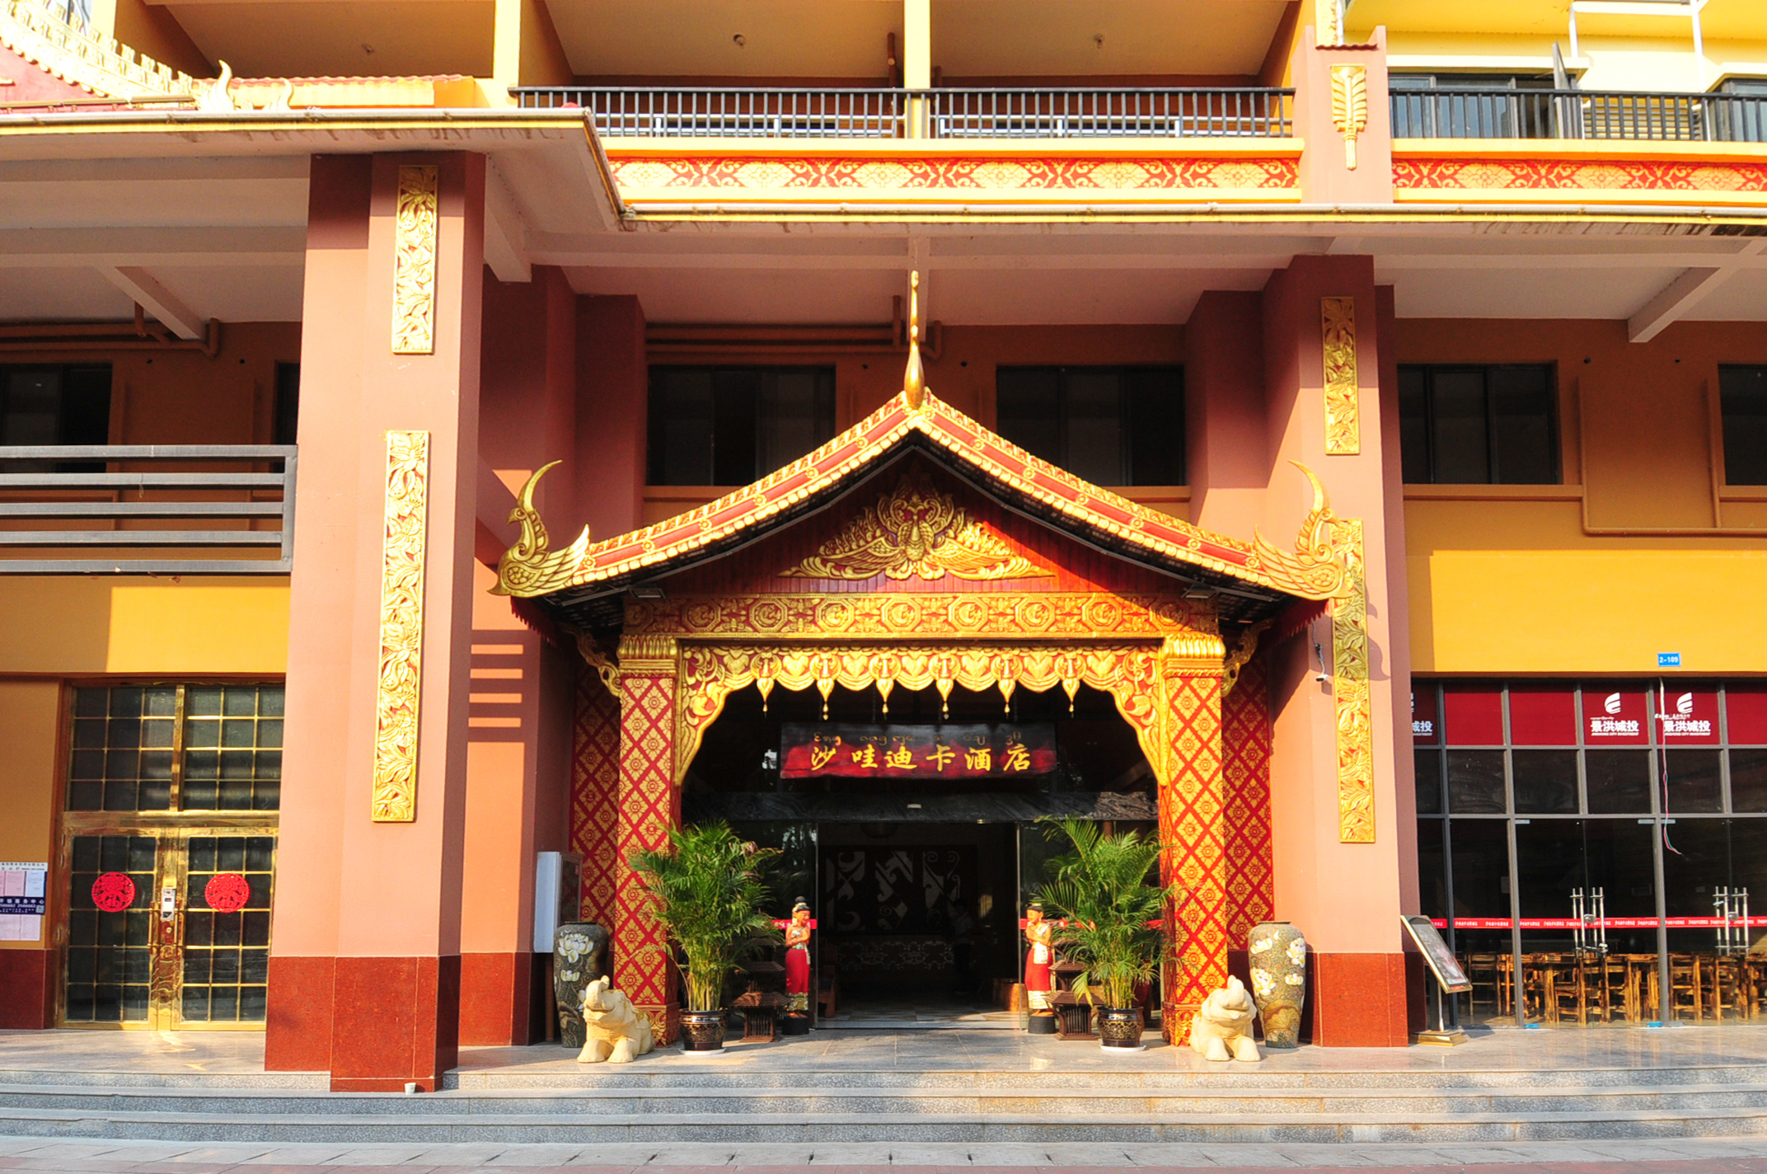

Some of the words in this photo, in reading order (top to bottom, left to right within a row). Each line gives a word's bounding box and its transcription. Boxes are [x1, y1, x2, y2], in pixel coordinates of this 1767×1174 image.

[1590, 720, 1639, 732] 景洪城投
[1663, 720, 1711, 732] 景洪城投
[811, 743, 1031, 771] 沙哇迪卡酒店
